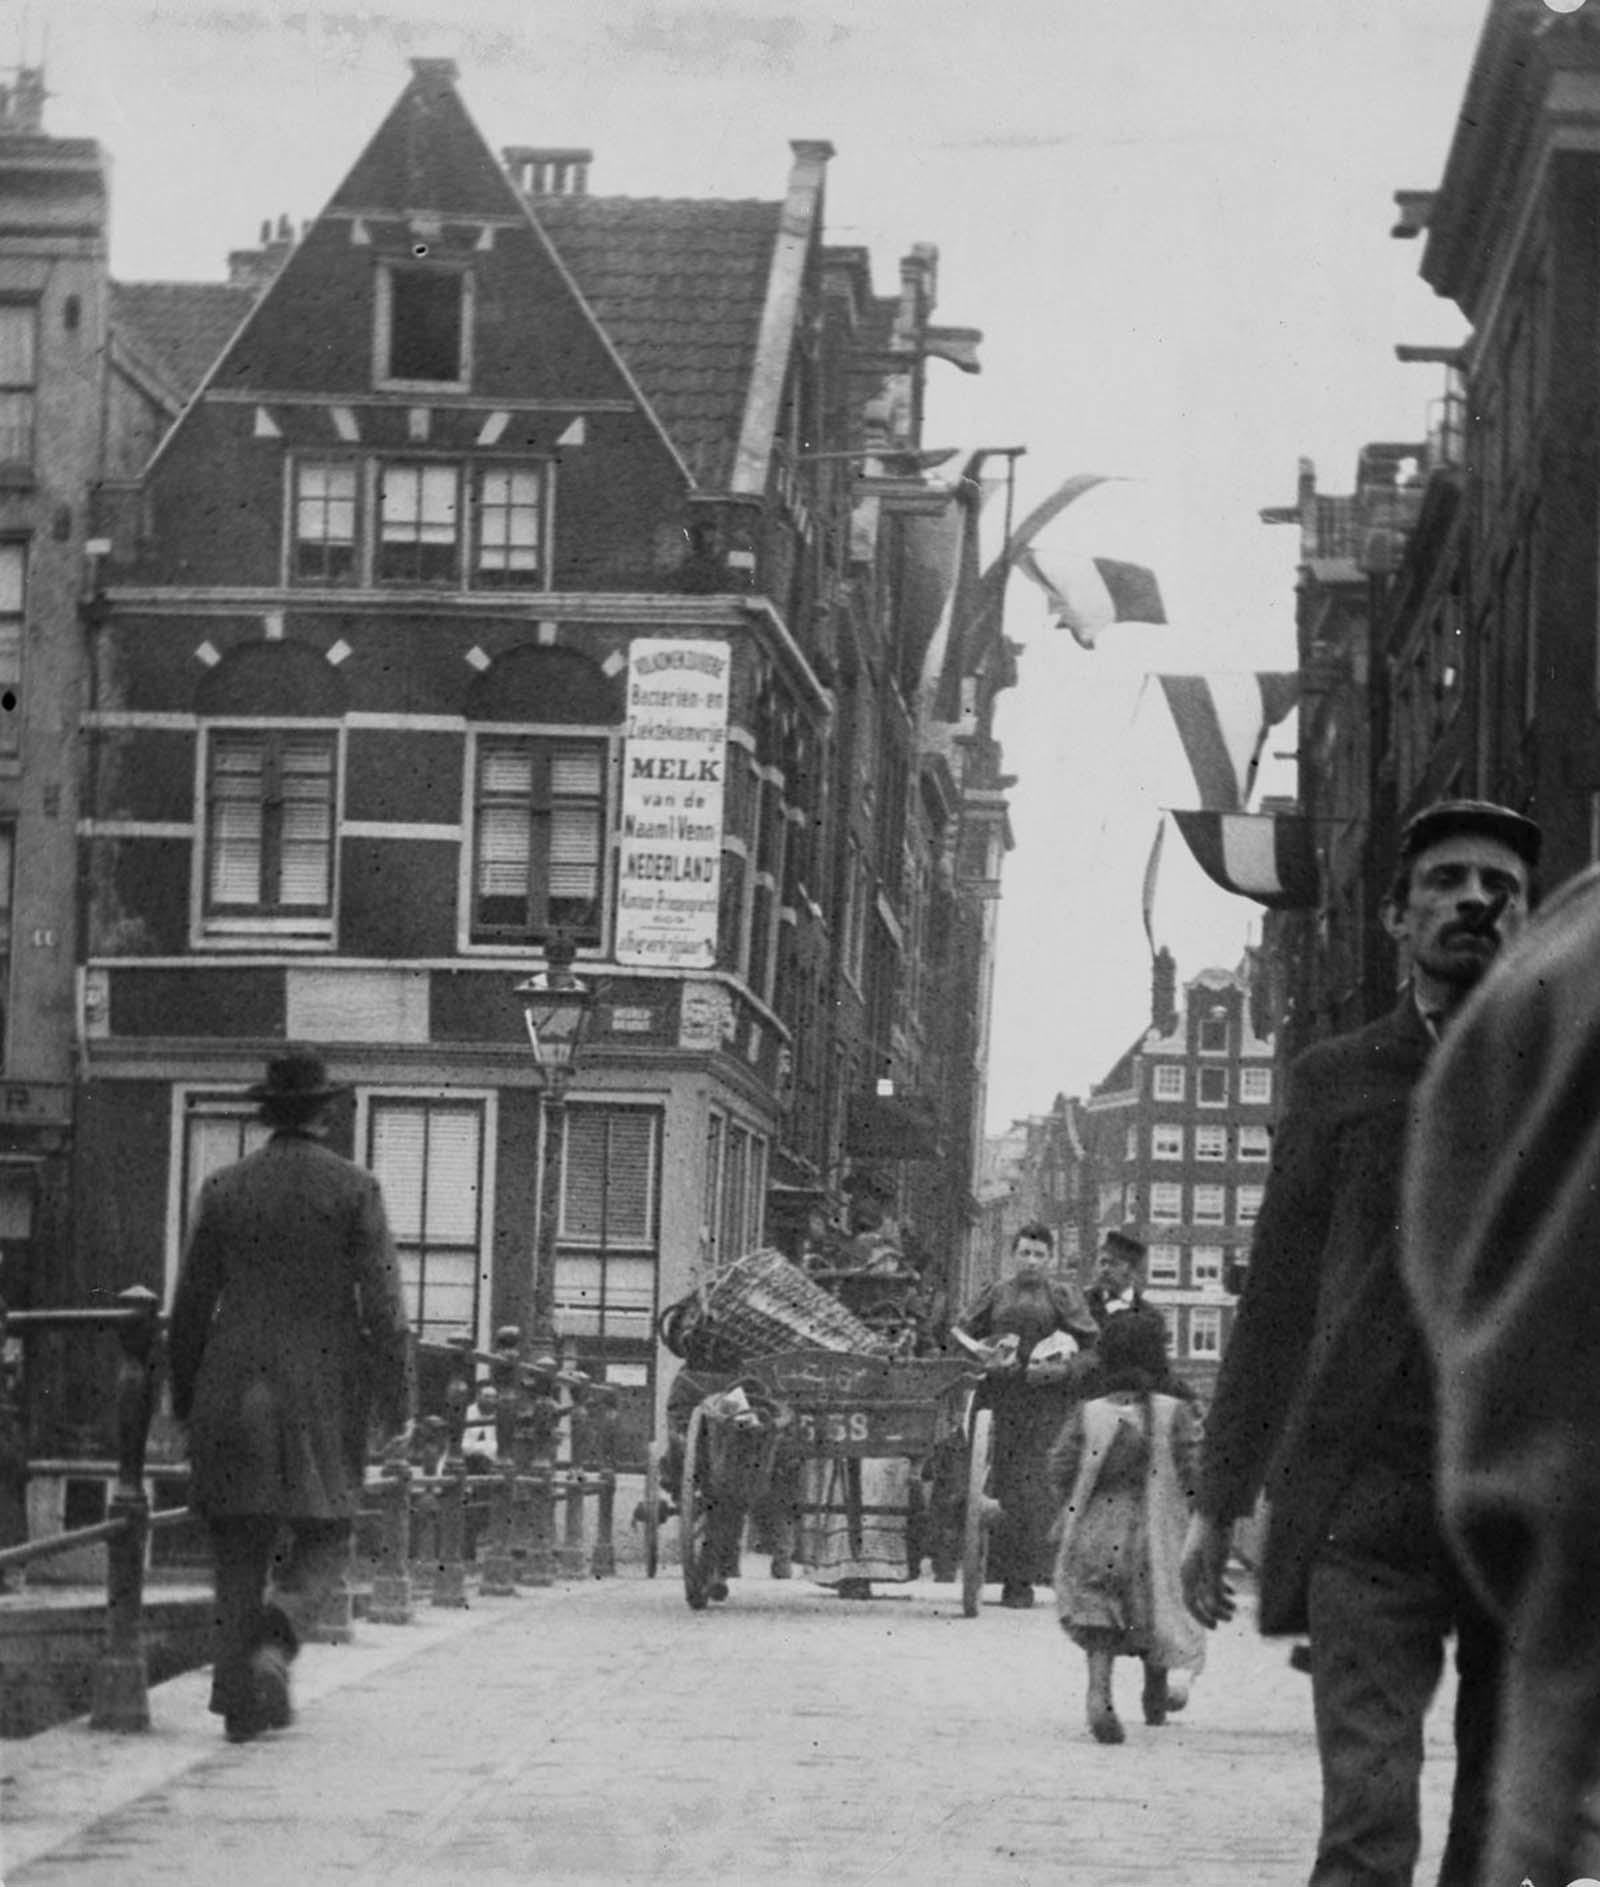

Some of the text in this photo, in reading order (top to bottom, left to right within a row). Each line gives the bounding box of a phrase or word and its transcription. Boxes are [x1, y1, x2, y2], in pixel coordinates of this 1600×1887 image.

[631, 757, 722, 782] MELK
[642, 788, 706, 808] van de
